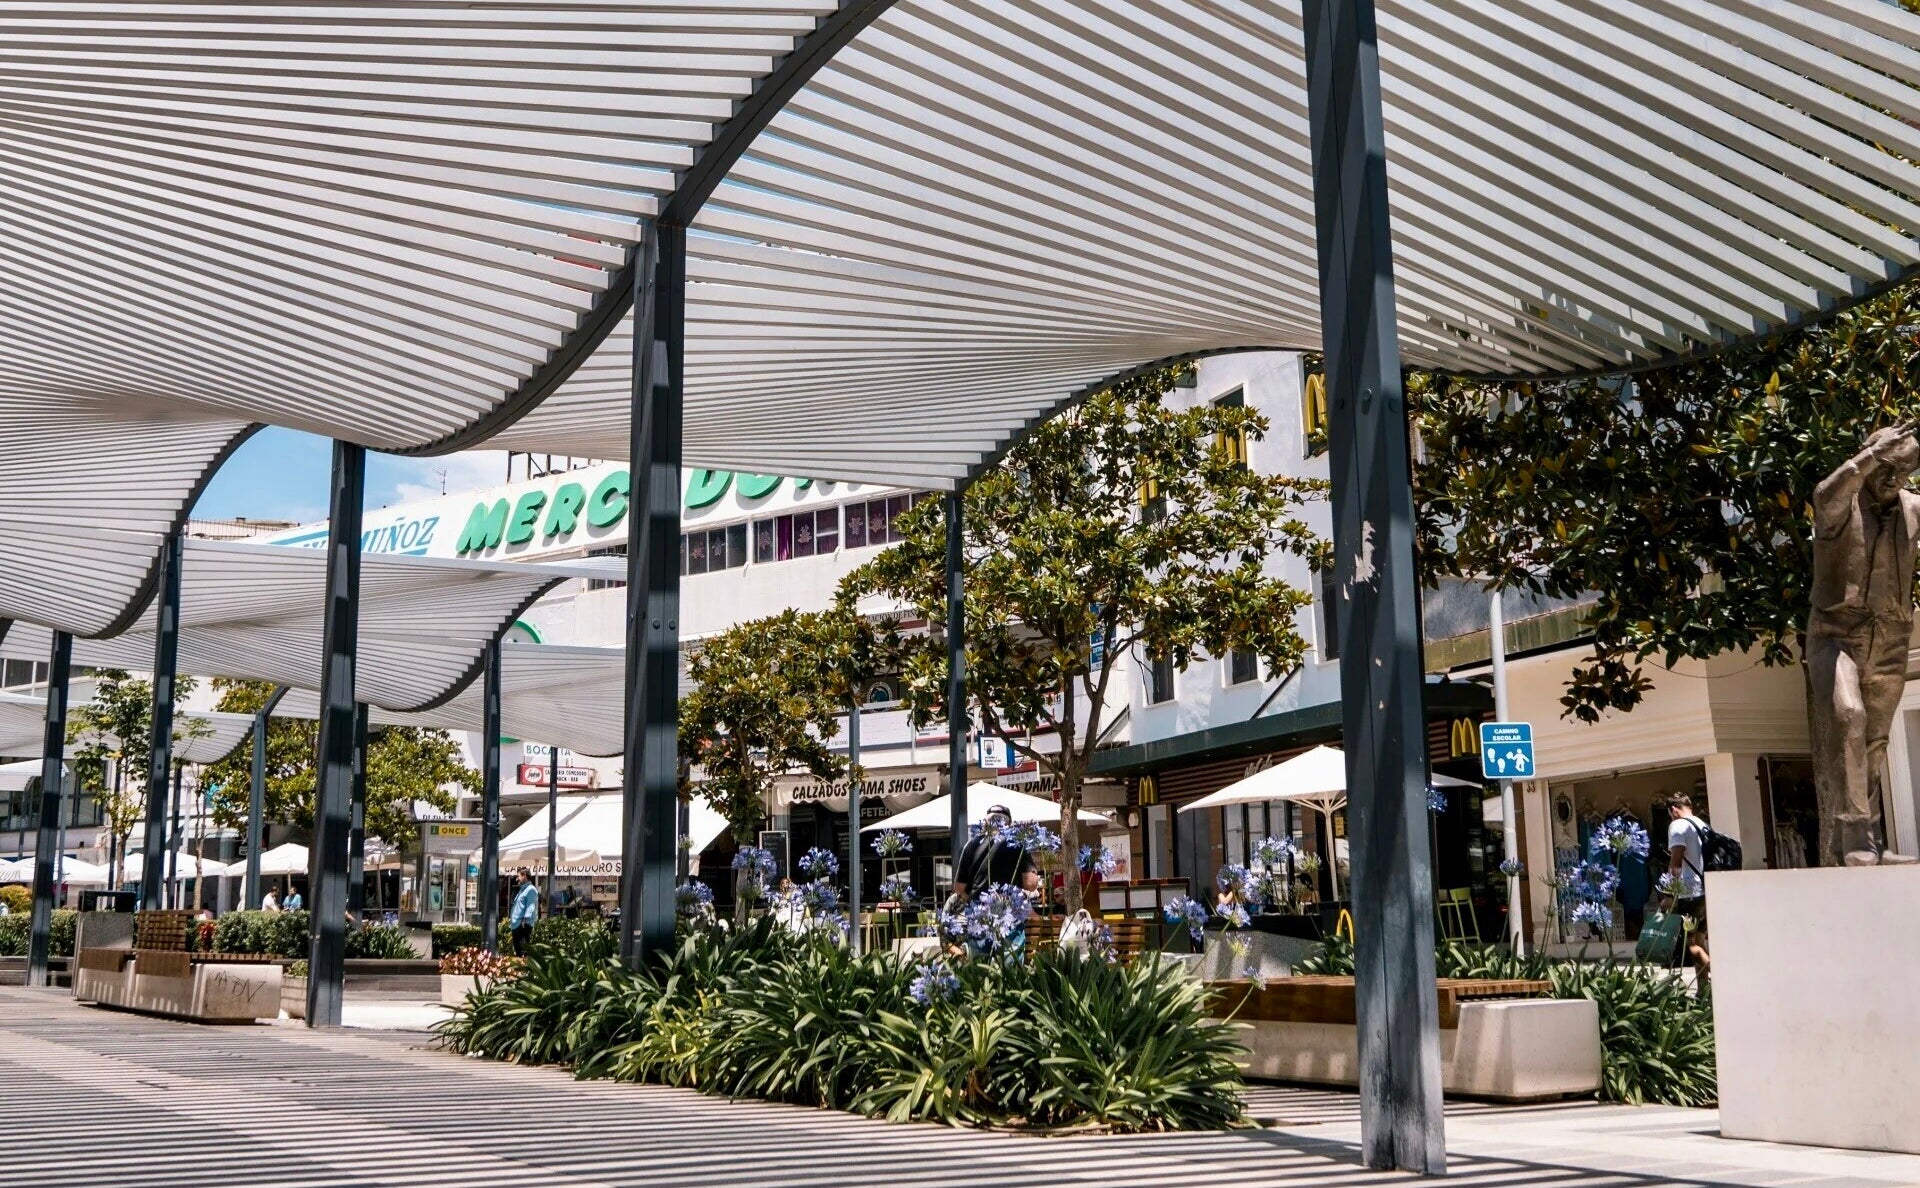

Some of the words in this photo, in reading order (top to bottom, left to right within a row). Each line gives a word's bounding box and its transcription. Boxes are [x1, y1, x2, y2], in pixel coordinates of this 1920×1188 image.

[792, 782, 848, 800] CALZADOS
[859, 780, 884, 796] AMA
[888, 777, 926, 794] SHOES
[441, 827, 466, 835] ONCE
